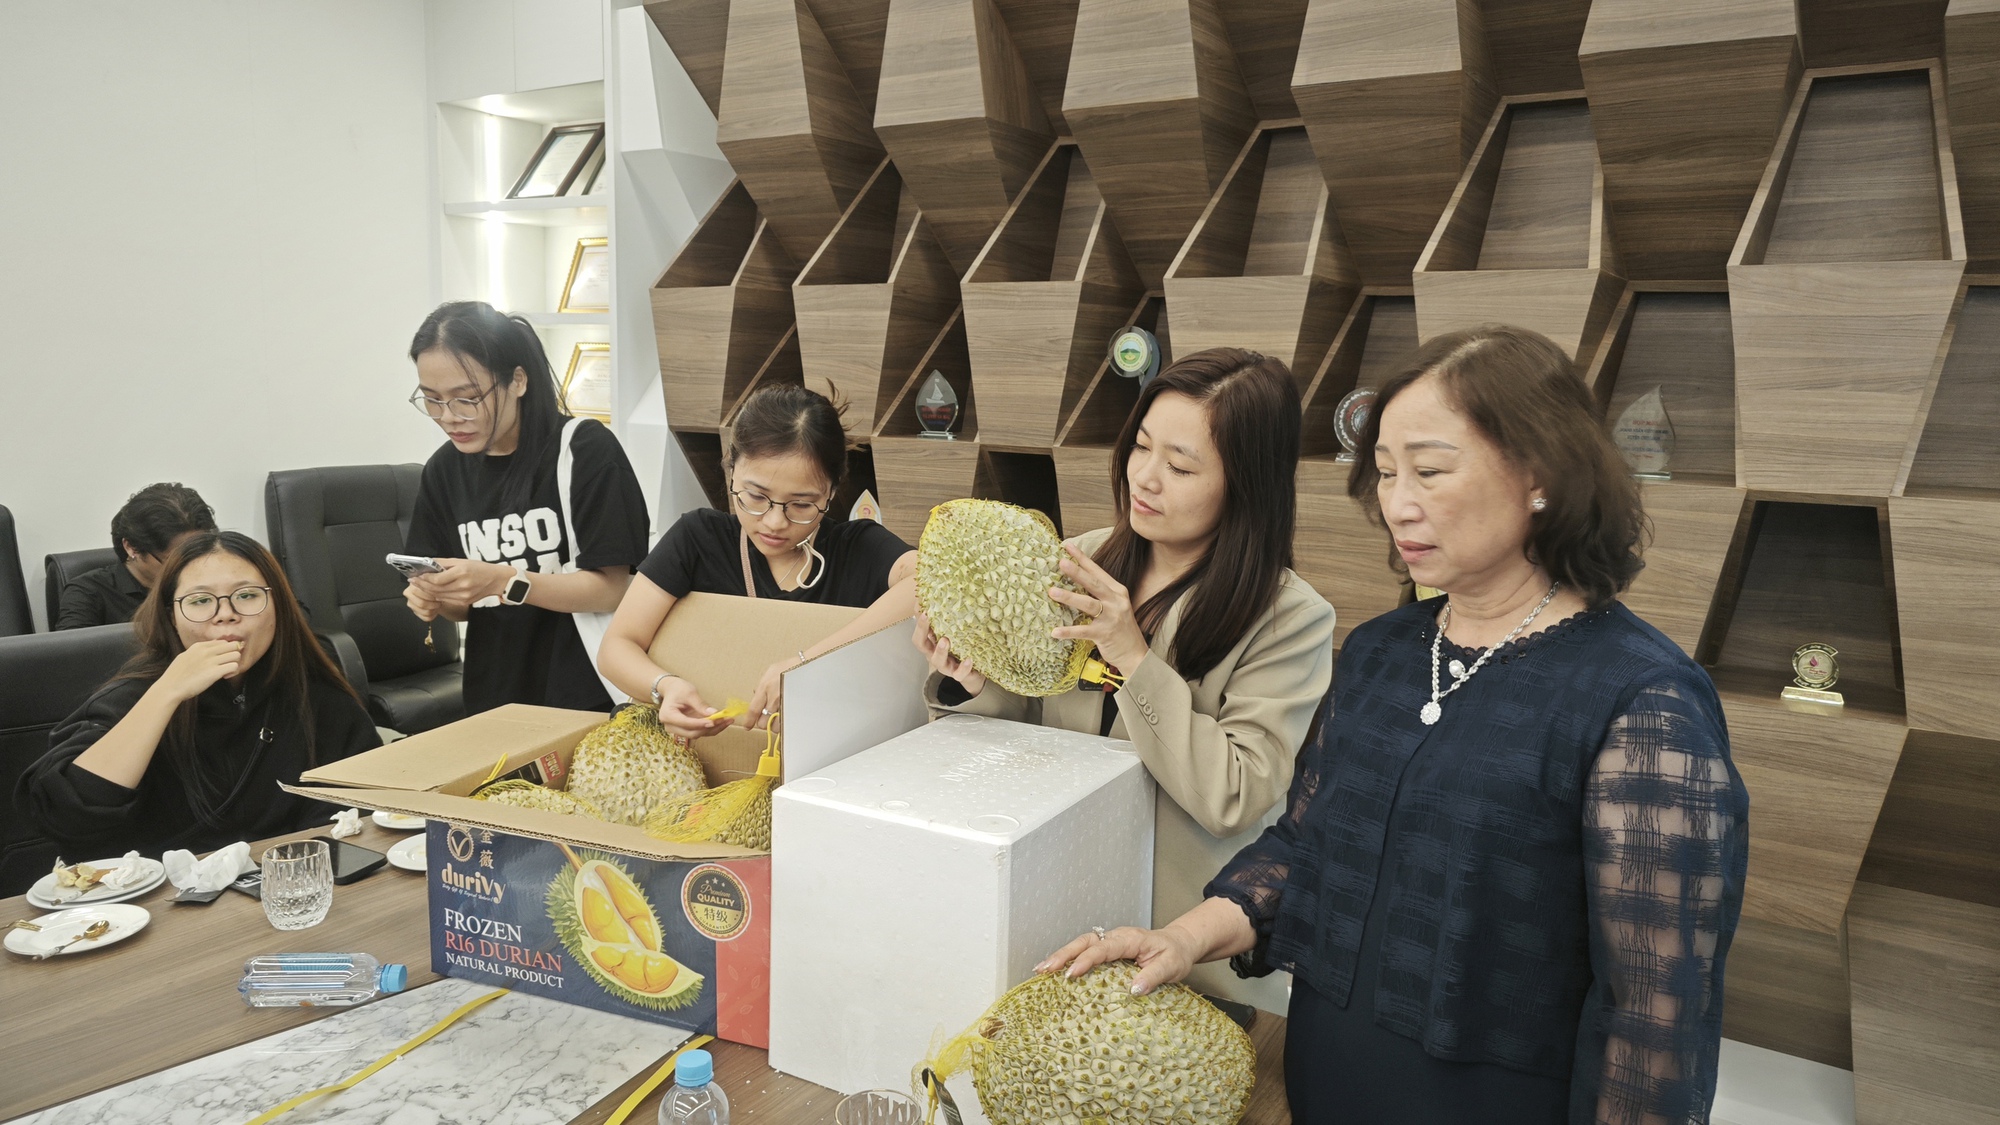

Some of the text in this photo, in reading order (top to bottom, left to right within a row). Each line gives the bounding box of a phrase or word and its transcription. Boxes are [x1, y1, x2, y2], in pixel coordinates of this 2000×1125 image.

[697, 893, 735, 907] QUALITY
[700, 883, 731, 898] Premium
[444, 907, 522, 943] FROZEN
[704, 907, 728, 924] 特级
[479, 939, 562, 972] DURIAN
[445, 952, 565, 988] NATURAL PRODUCT
